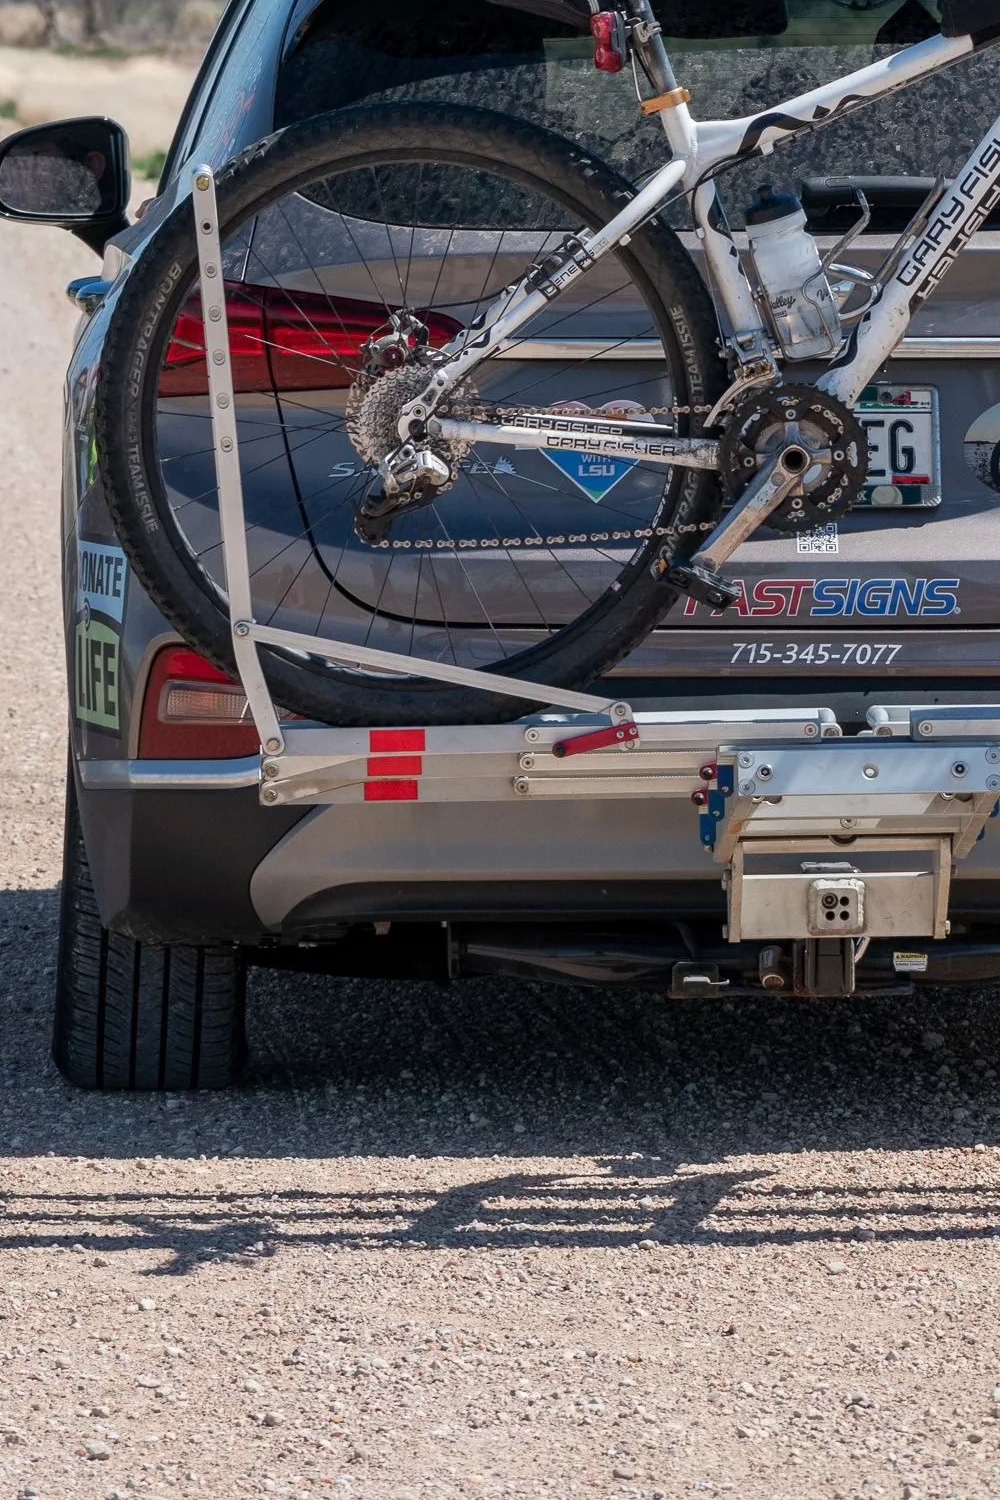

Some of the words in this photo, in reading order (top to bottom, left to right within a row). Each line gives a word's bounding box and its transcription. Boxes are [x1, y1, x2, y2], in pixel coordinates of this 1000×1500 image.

[896, 196, 965, 286] GARY
[684, 348, 704, 394] TEAM
[501, 414, 551, 430] GARY
[547, 436, 600, 450] GARY
[127, 444, 144, 489] TEAM
[578, 464, 615, 477] LSU
[135, 491, 159, 533] ISSUE
[78, 634, 116, 716] LIFE
[730, 643, 902, 665] 715-345-7077
